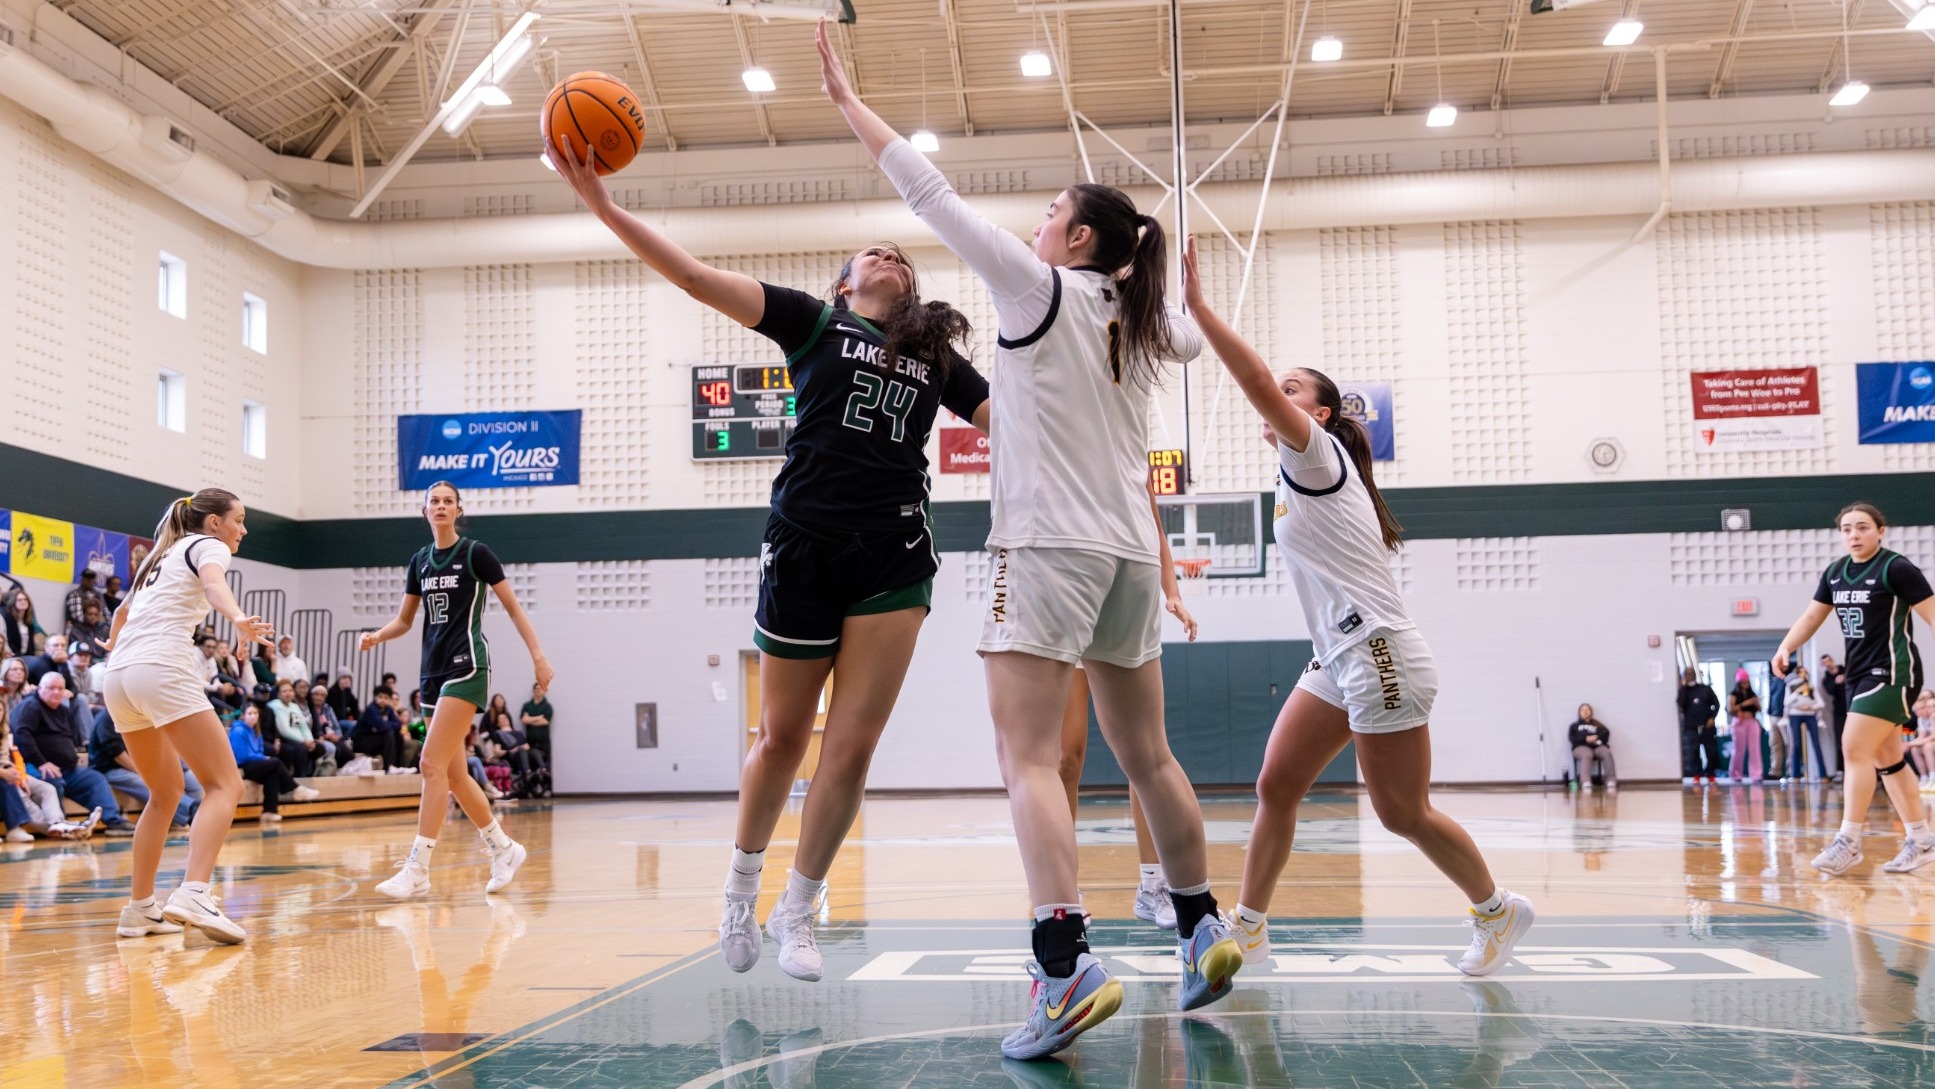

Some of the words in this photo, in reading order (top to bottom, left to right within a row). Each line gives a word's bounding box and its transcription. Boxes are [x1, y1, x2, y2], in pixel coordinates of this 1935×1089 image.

[841, 338, 888, 368] LAKE
[895, 355, 931, 385] ERIE
[698, 368, 729, 379] HOME
[1703, 379, 1733, 388] Taking
[1734, 378, 1754, 387] Care
[1756, 376, 1767, 385] of
[1767, 376, 1806, 385] Athletes
[702, 383, 730, 405] 40
[1710, 390, 1732, 399] from
[1750, 388, 1772, 398] Wee
[1773, 388, 1783, 397] to
[1784, 387, 1801, 396] Pro
[709, 408, 735, 418] BONUS
[785, 397, 795, 416] 3
[842, 370, 918, 442] 24
[1342, 399, 1362, 414] 50
[468, 421, 527, 435] DIVISION
[705, 422, 730, 431] FOULS
[717, 431, 730, 450] 3
[418, 455, 469, 471] MAKE
[471, 453, 489, 469] IT
[488, 441, 560, 476] YOURS
[1150, 450, 1183, 467] 1:07
[1153, 468, 1177, 494] 18
[420, 577, 439, 592] LAKE
[439, 575, 459, 589] ERIE
[1832, 590, 1851, 604] LAKE
[1851, 590, 1871, 604] ERIE
[427, 592, 449, 625] 12
[1837, 607, 1865, 638] 32
[1369, 637, 1402, 711] PANTHERS
